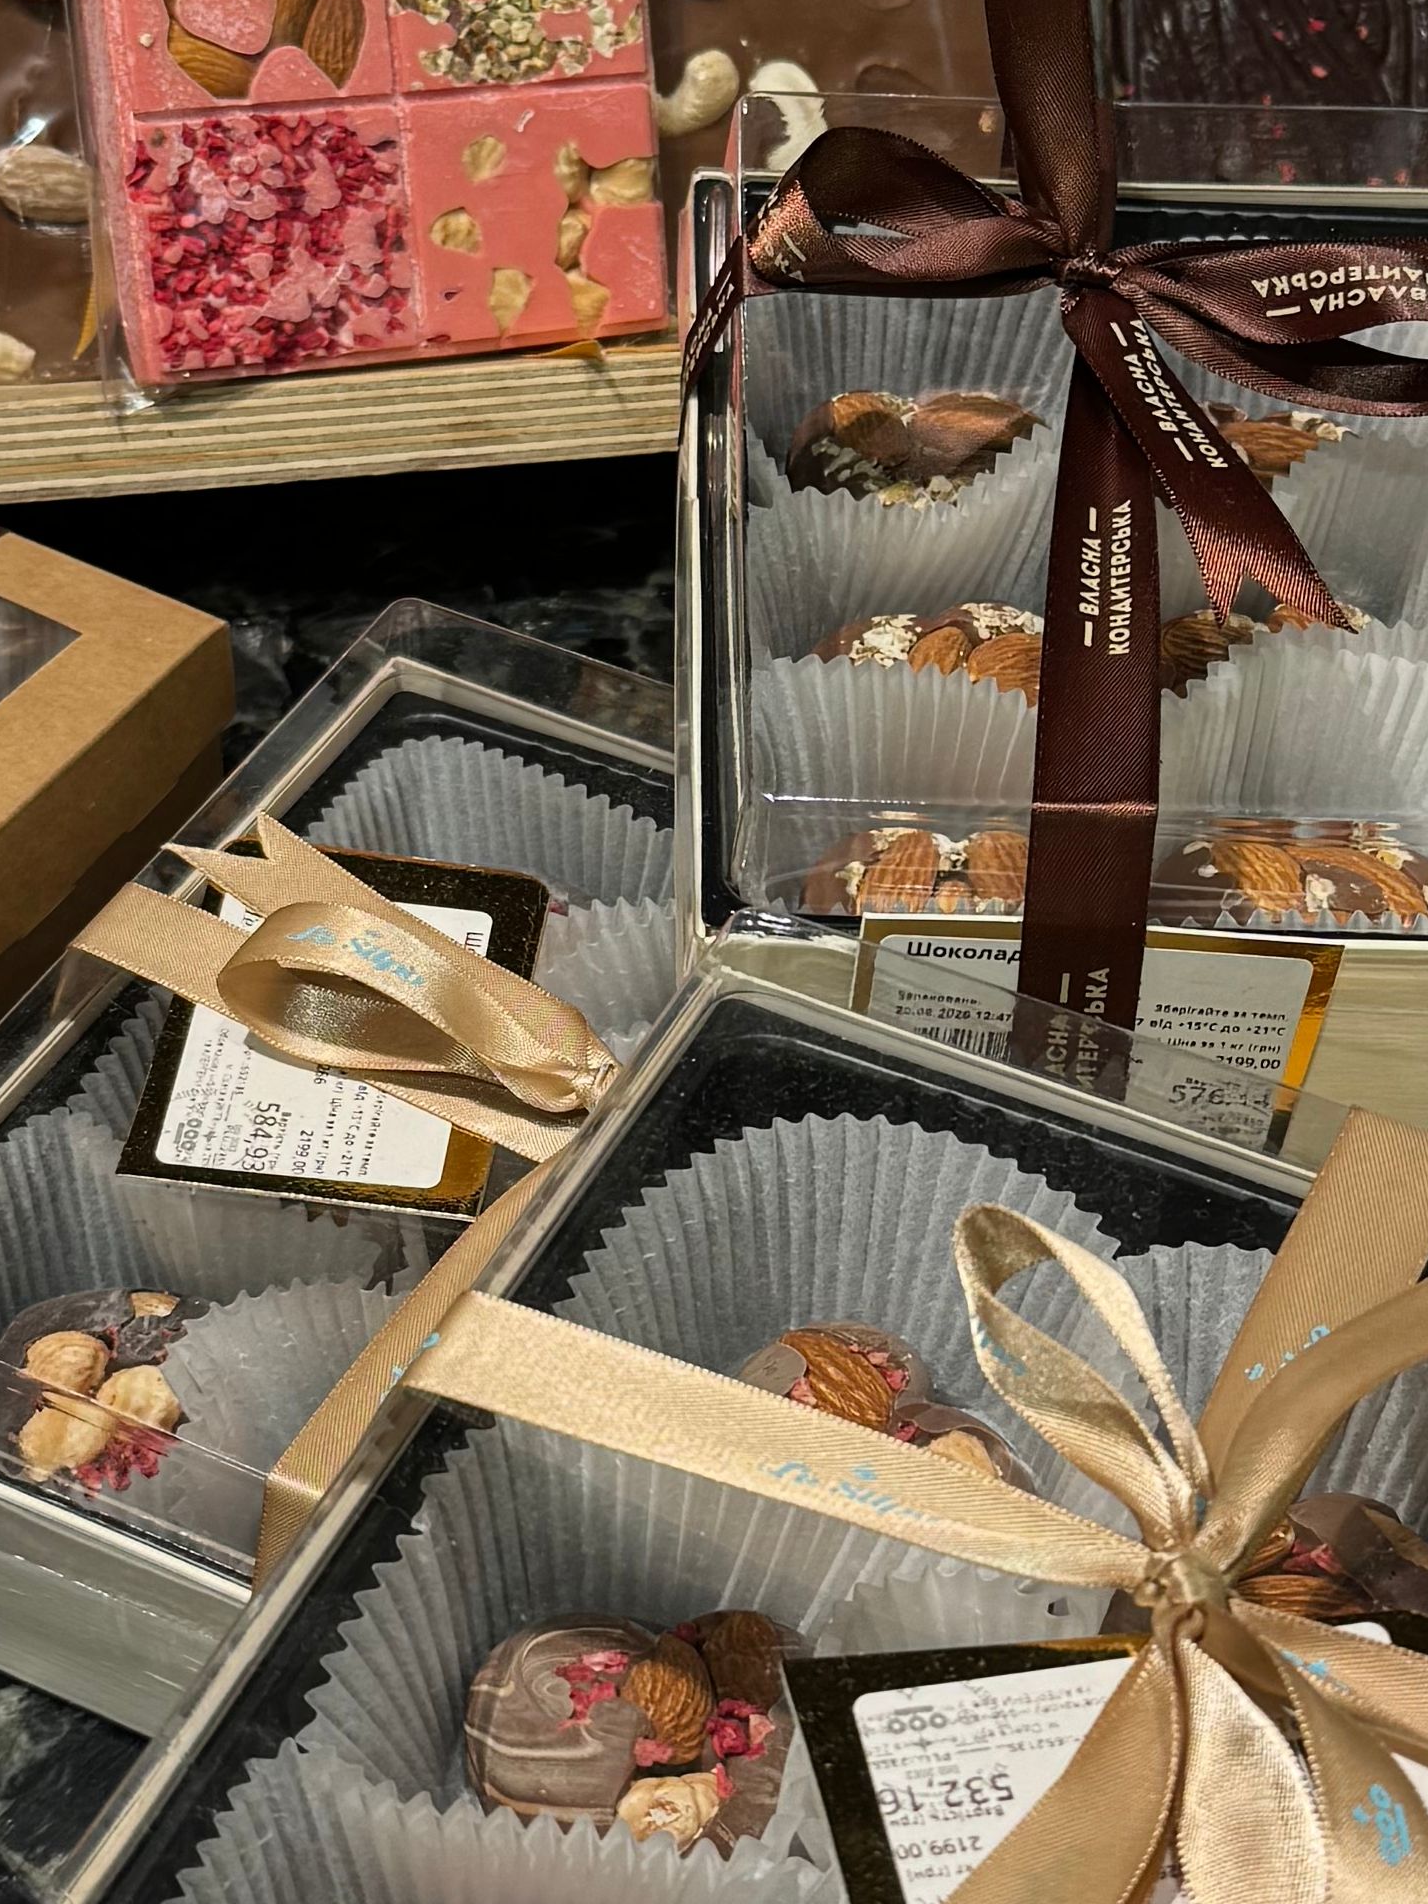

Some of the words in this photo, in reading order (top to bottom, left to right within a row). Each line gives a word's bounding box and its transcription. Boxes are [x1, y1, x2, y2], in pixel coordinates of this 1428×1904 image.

[1310, 285, 1428, 315] ВЛАСНА
[1123, 352, 1177, 433] ВЛАСНА
[1130, 319, 1229, 469] КОНДИТЕРСЬКА
[1079, 536, 1103, 617] ВЛАСНА
[1108, 498, 1133, 657] КОНДИТЕРСЬКА
[1149, 1018, 1173, 1030] від
[1220, 1025, 1241, 1034] до
[242, 1101, 281, 1172] 584,93
[877, 1772, 1014, 1816] 532,16
